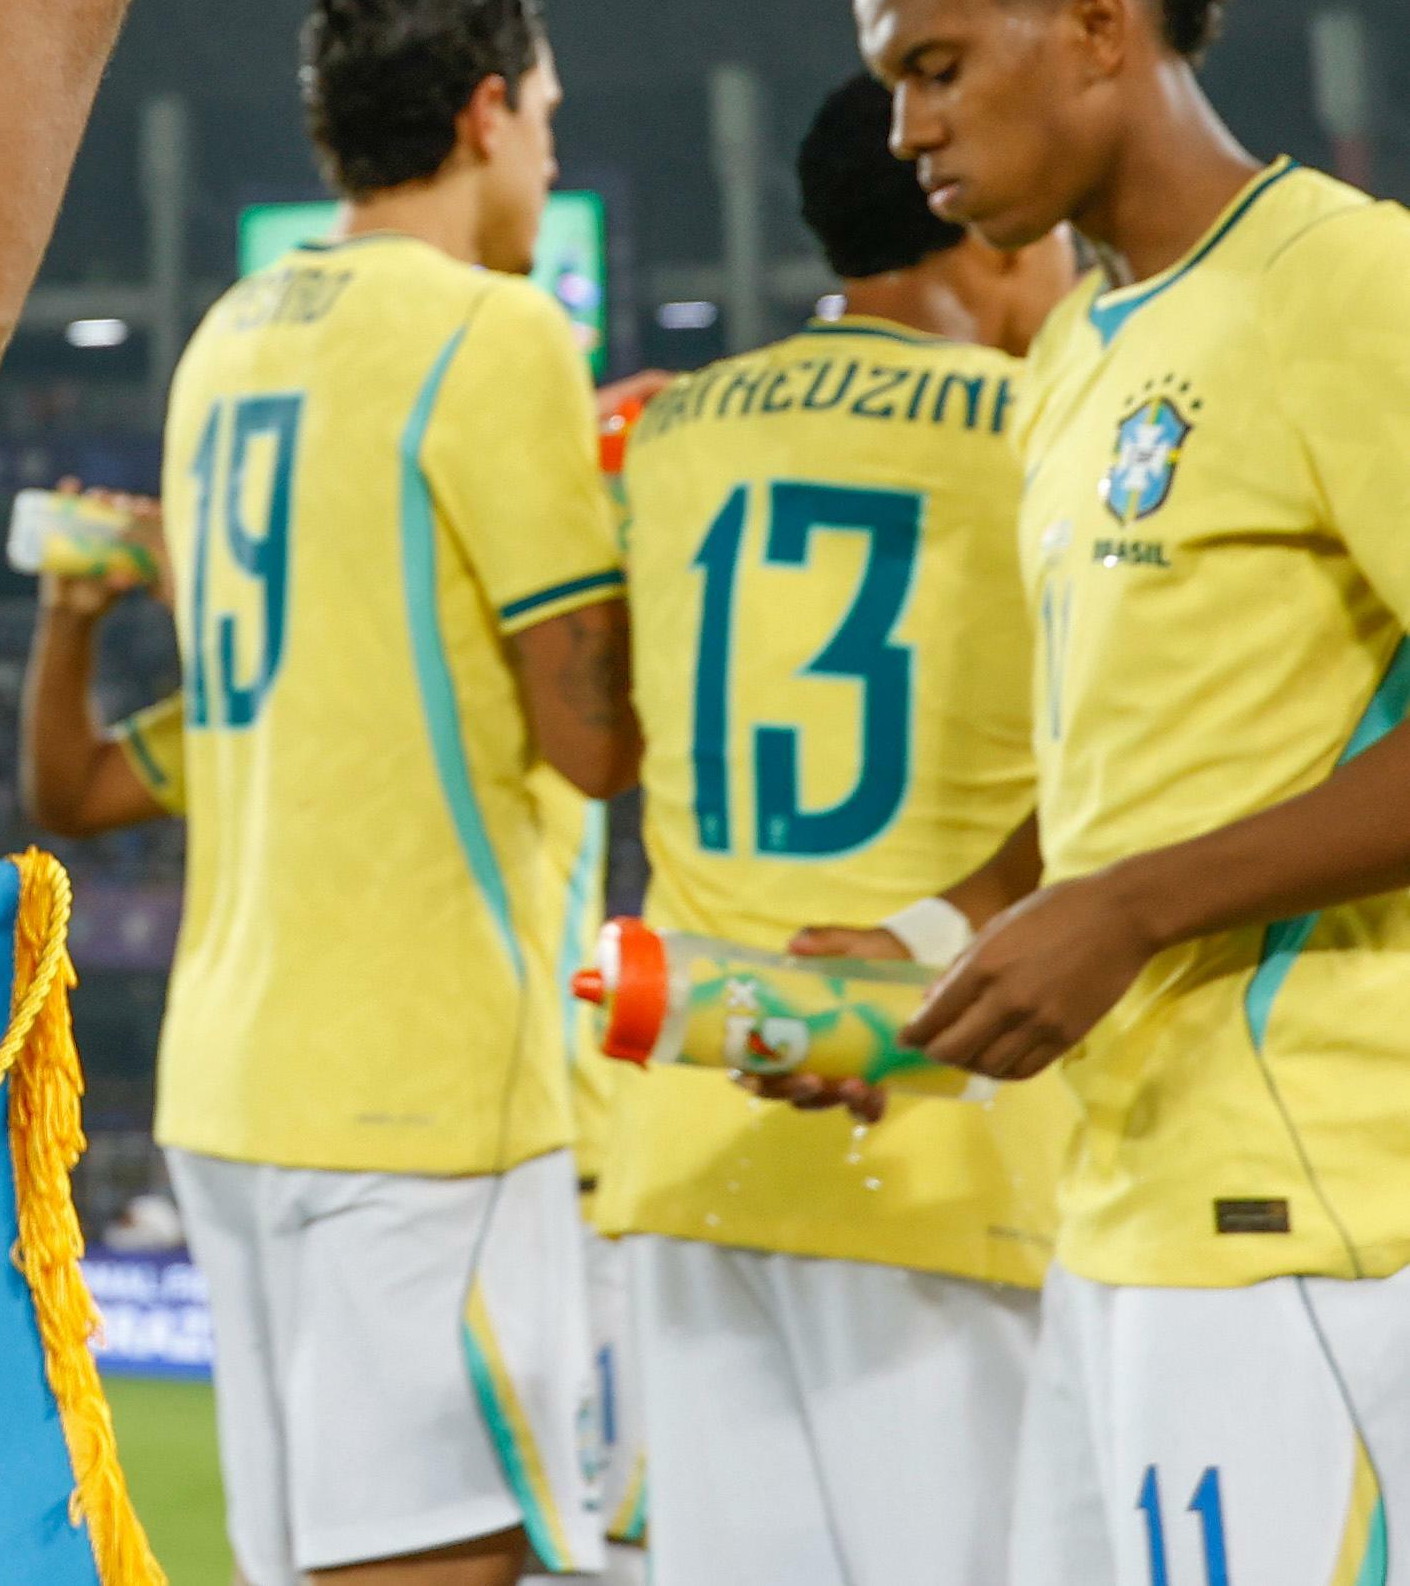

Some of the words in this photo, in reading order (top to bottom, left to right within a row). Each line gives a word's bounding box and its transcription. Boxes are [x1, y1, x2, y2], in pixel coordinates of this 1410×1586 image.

[184, 392, 305, 730] 19
[690, 481, 926, 860] 13
[1135, 1463, 1230, 1586] 11
